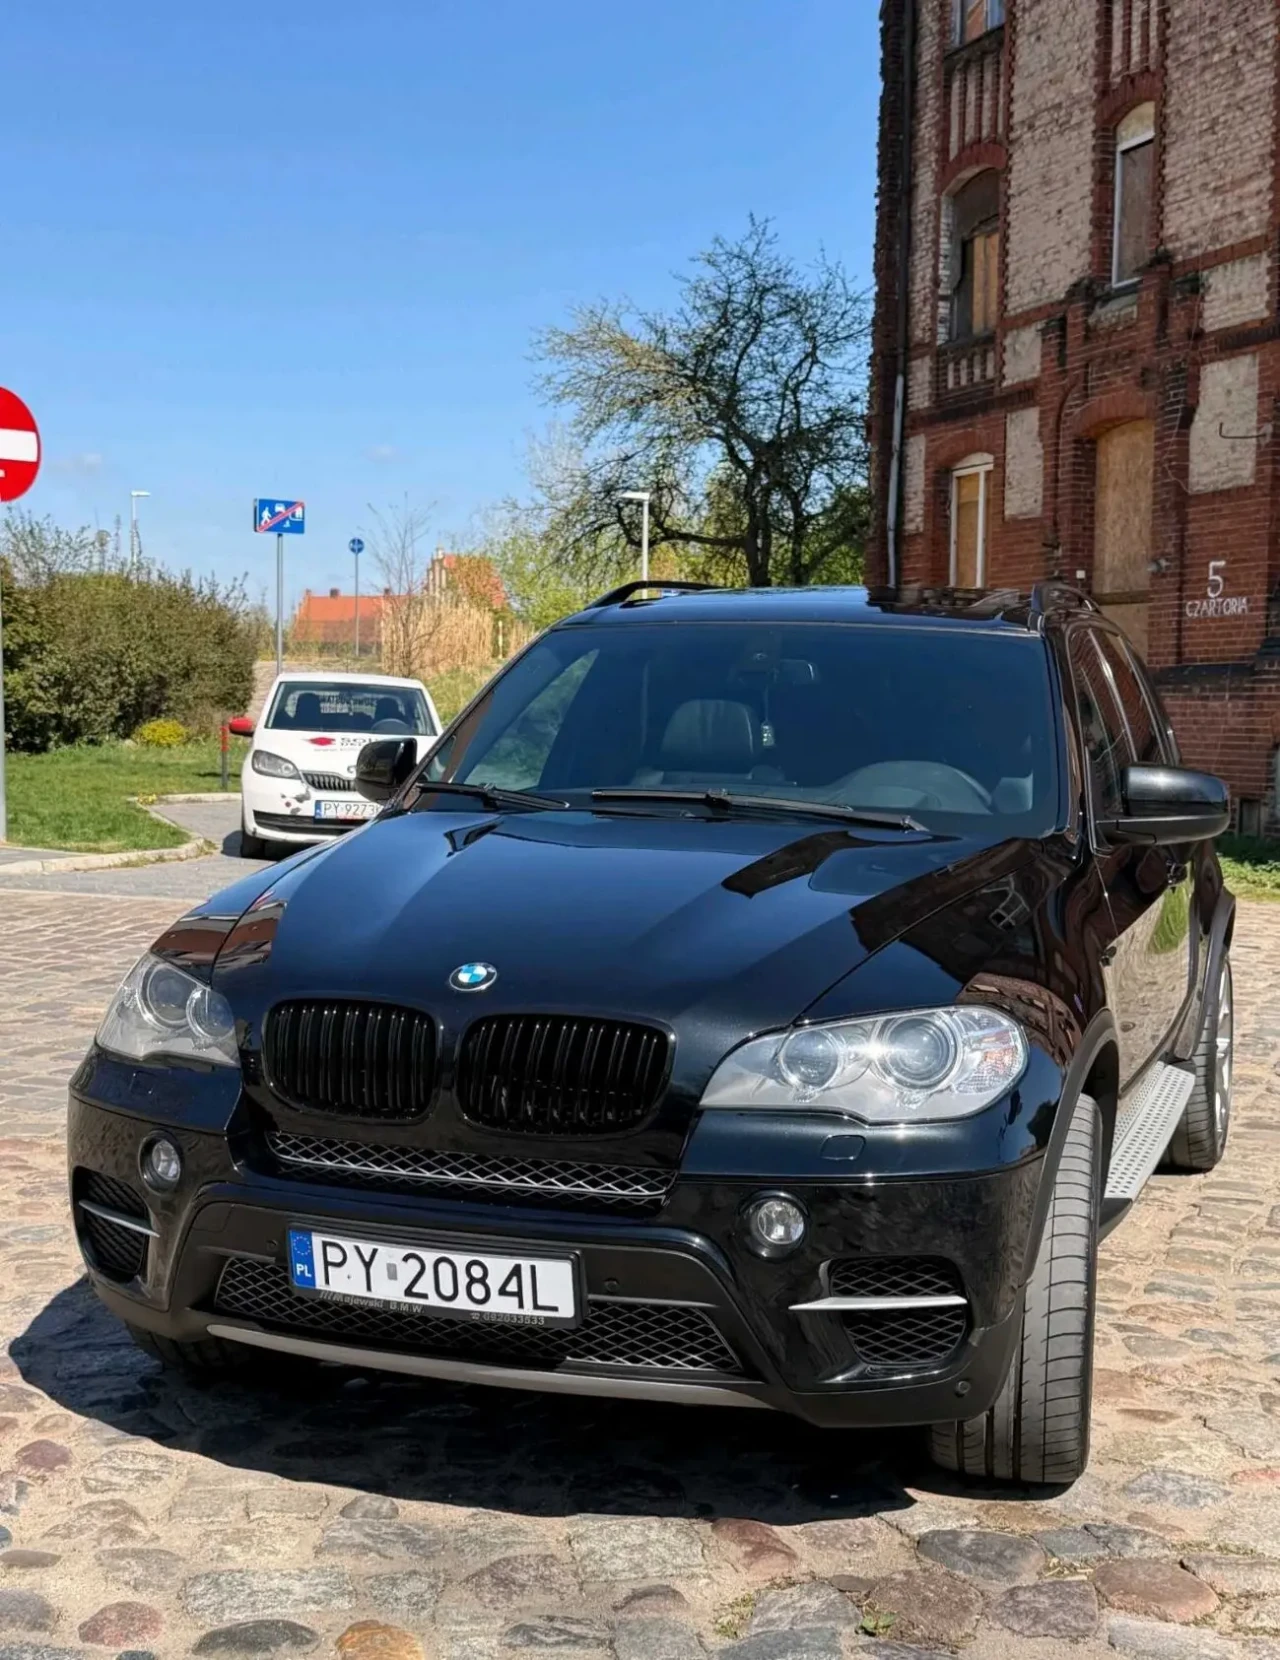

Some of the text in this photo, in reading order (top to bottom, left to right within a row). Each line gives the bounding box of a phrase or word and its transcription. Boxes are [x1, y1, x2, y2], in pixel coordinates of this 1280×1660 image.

[1206, 560, 1226, 598] 5
[323, 802, 340, 816] PY
[296, 1263, 312, 1278] PL
[321, 1240, 559, 1312] PY 2084L
